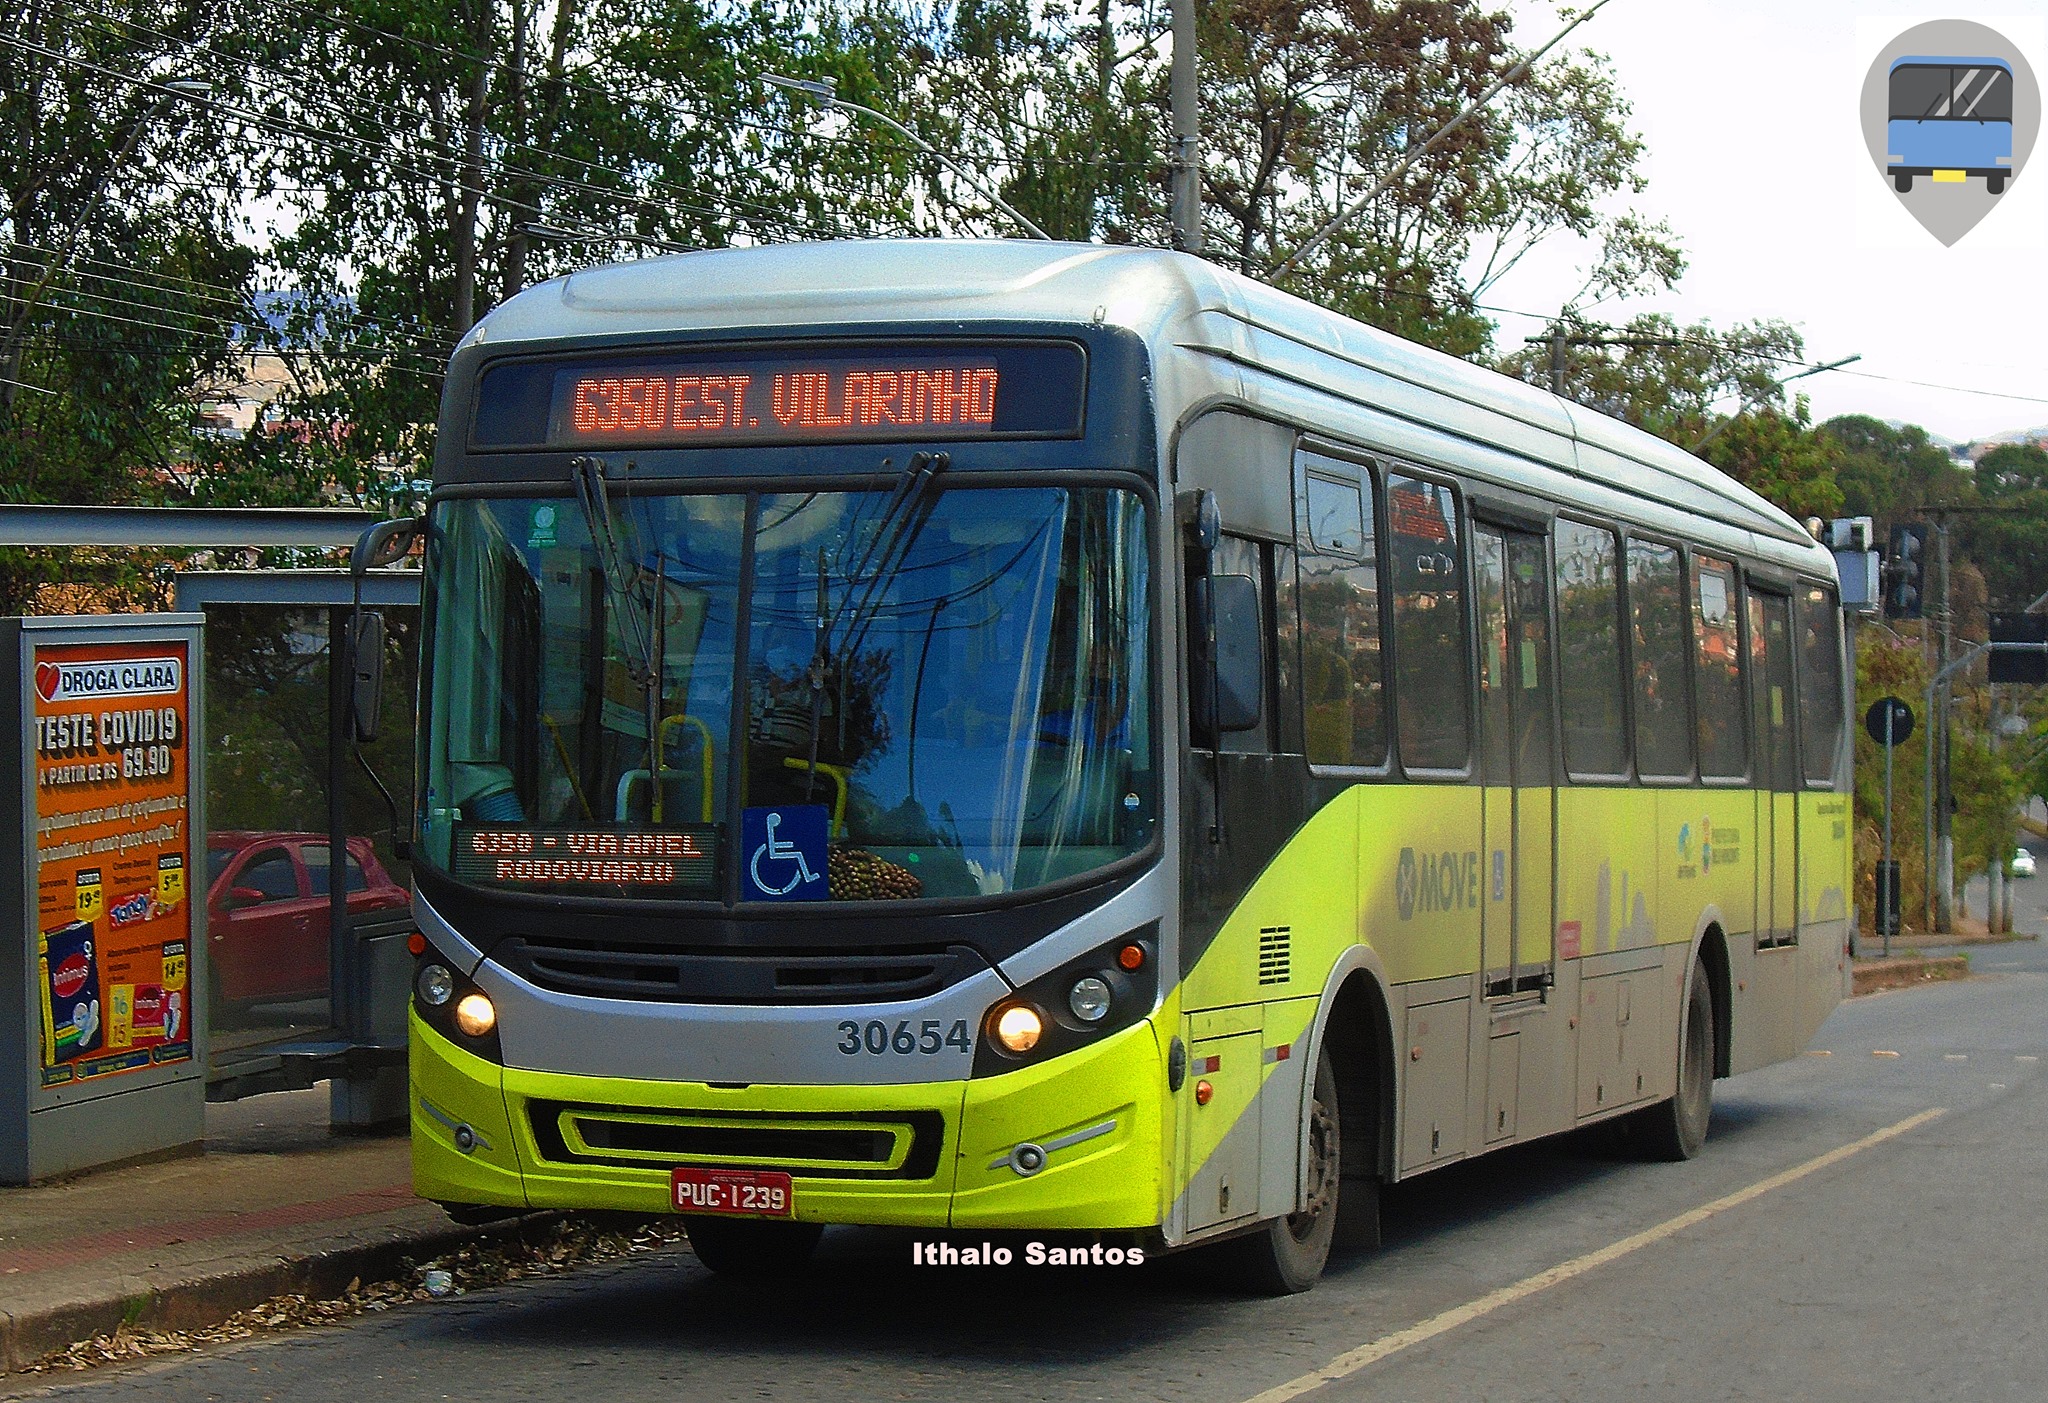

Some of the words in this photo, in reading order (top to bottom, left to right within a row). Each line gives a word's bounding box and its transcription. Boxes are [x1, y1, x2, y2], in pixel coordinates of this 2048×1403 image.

[573, 377, 667, 430] 6350
[672, 375, 758, 429] EST.
[773, 368, 998, 426] VILARINHO
[62, 669, 118, 692] DROGA
[122, 666, 175, 688] CLARA
[35, 714, 94, 750] TESTE
[38, 768, 45, 785] A
[49, 764, 86, 784] PARTIR
[88, 763, 101, 781] DE
[472, 832, 534, 855] 6350
[566, 833, 618, 856] VIA
[496, 859, 674, 883] RODOVIARIO
[1418, 851, 1477, 914] MOVE
[837, 1019, 972, 1055] 30654
